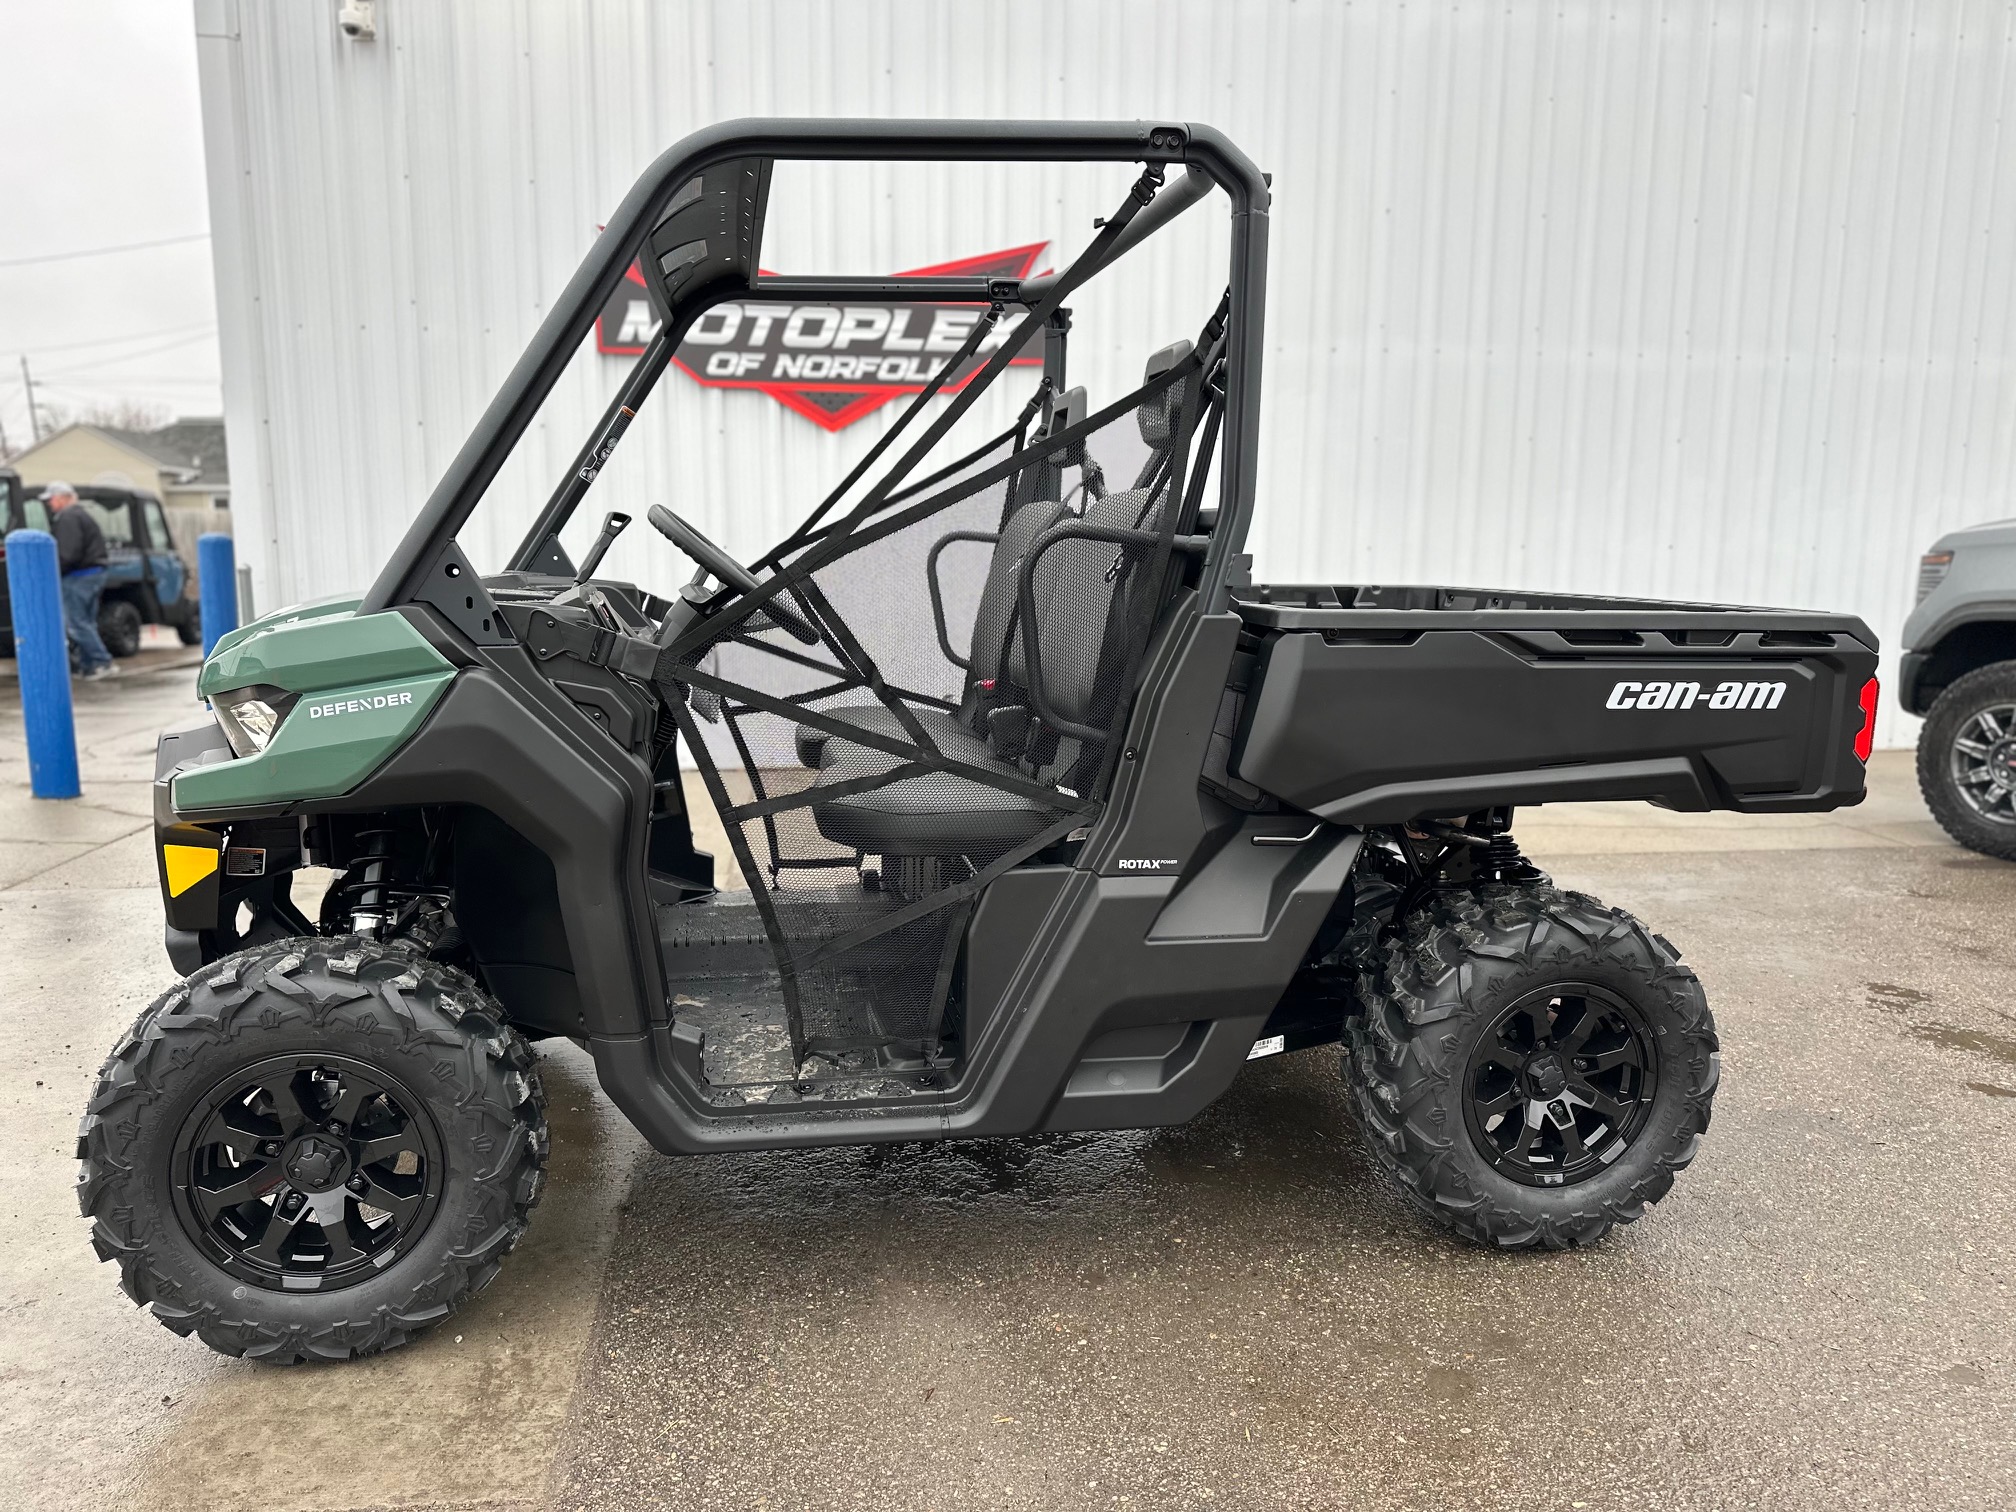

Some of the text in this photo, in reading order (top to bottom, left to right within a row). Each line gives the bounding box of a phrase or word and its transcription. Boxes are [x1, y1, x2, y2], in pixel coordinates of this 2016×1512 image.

[706, 351, 951, 382] OF NORFOLK
[309, 692, 412, 718] DEFENDER
[1605, 681, 1787, 709] can-am
[1118, 859, 1161, 869] ROTAX
